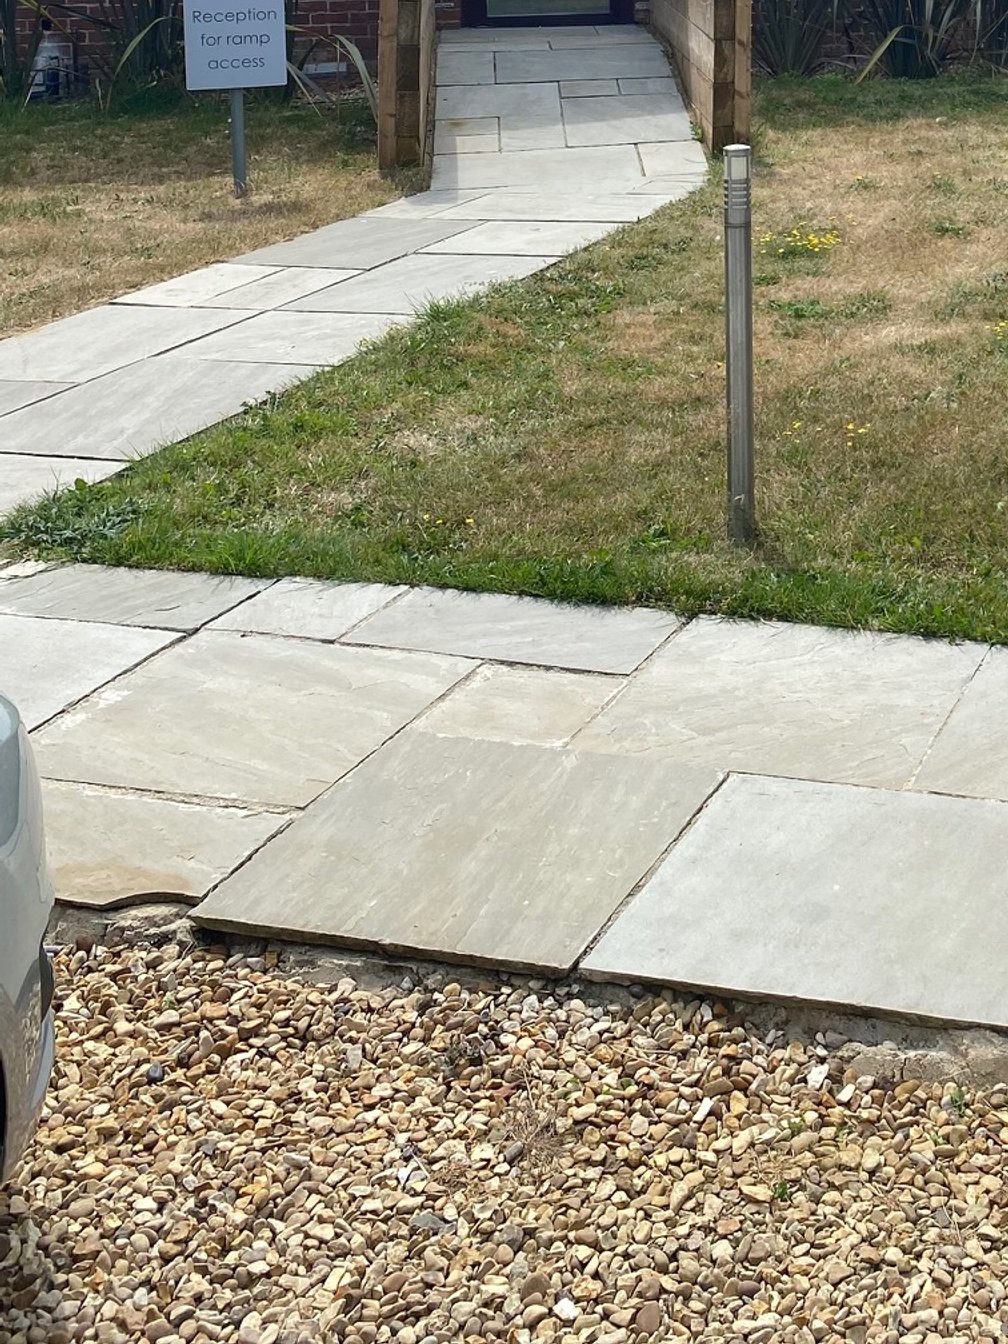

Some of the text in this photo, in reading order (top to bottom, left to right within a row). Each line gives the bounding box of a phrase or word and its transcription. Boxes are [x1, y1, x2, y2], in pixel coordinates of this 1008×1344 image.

[192, 7, 278, 24] Reception
[200, 32, 271, 47] for ramp
[207, 57, 266, 70] access
